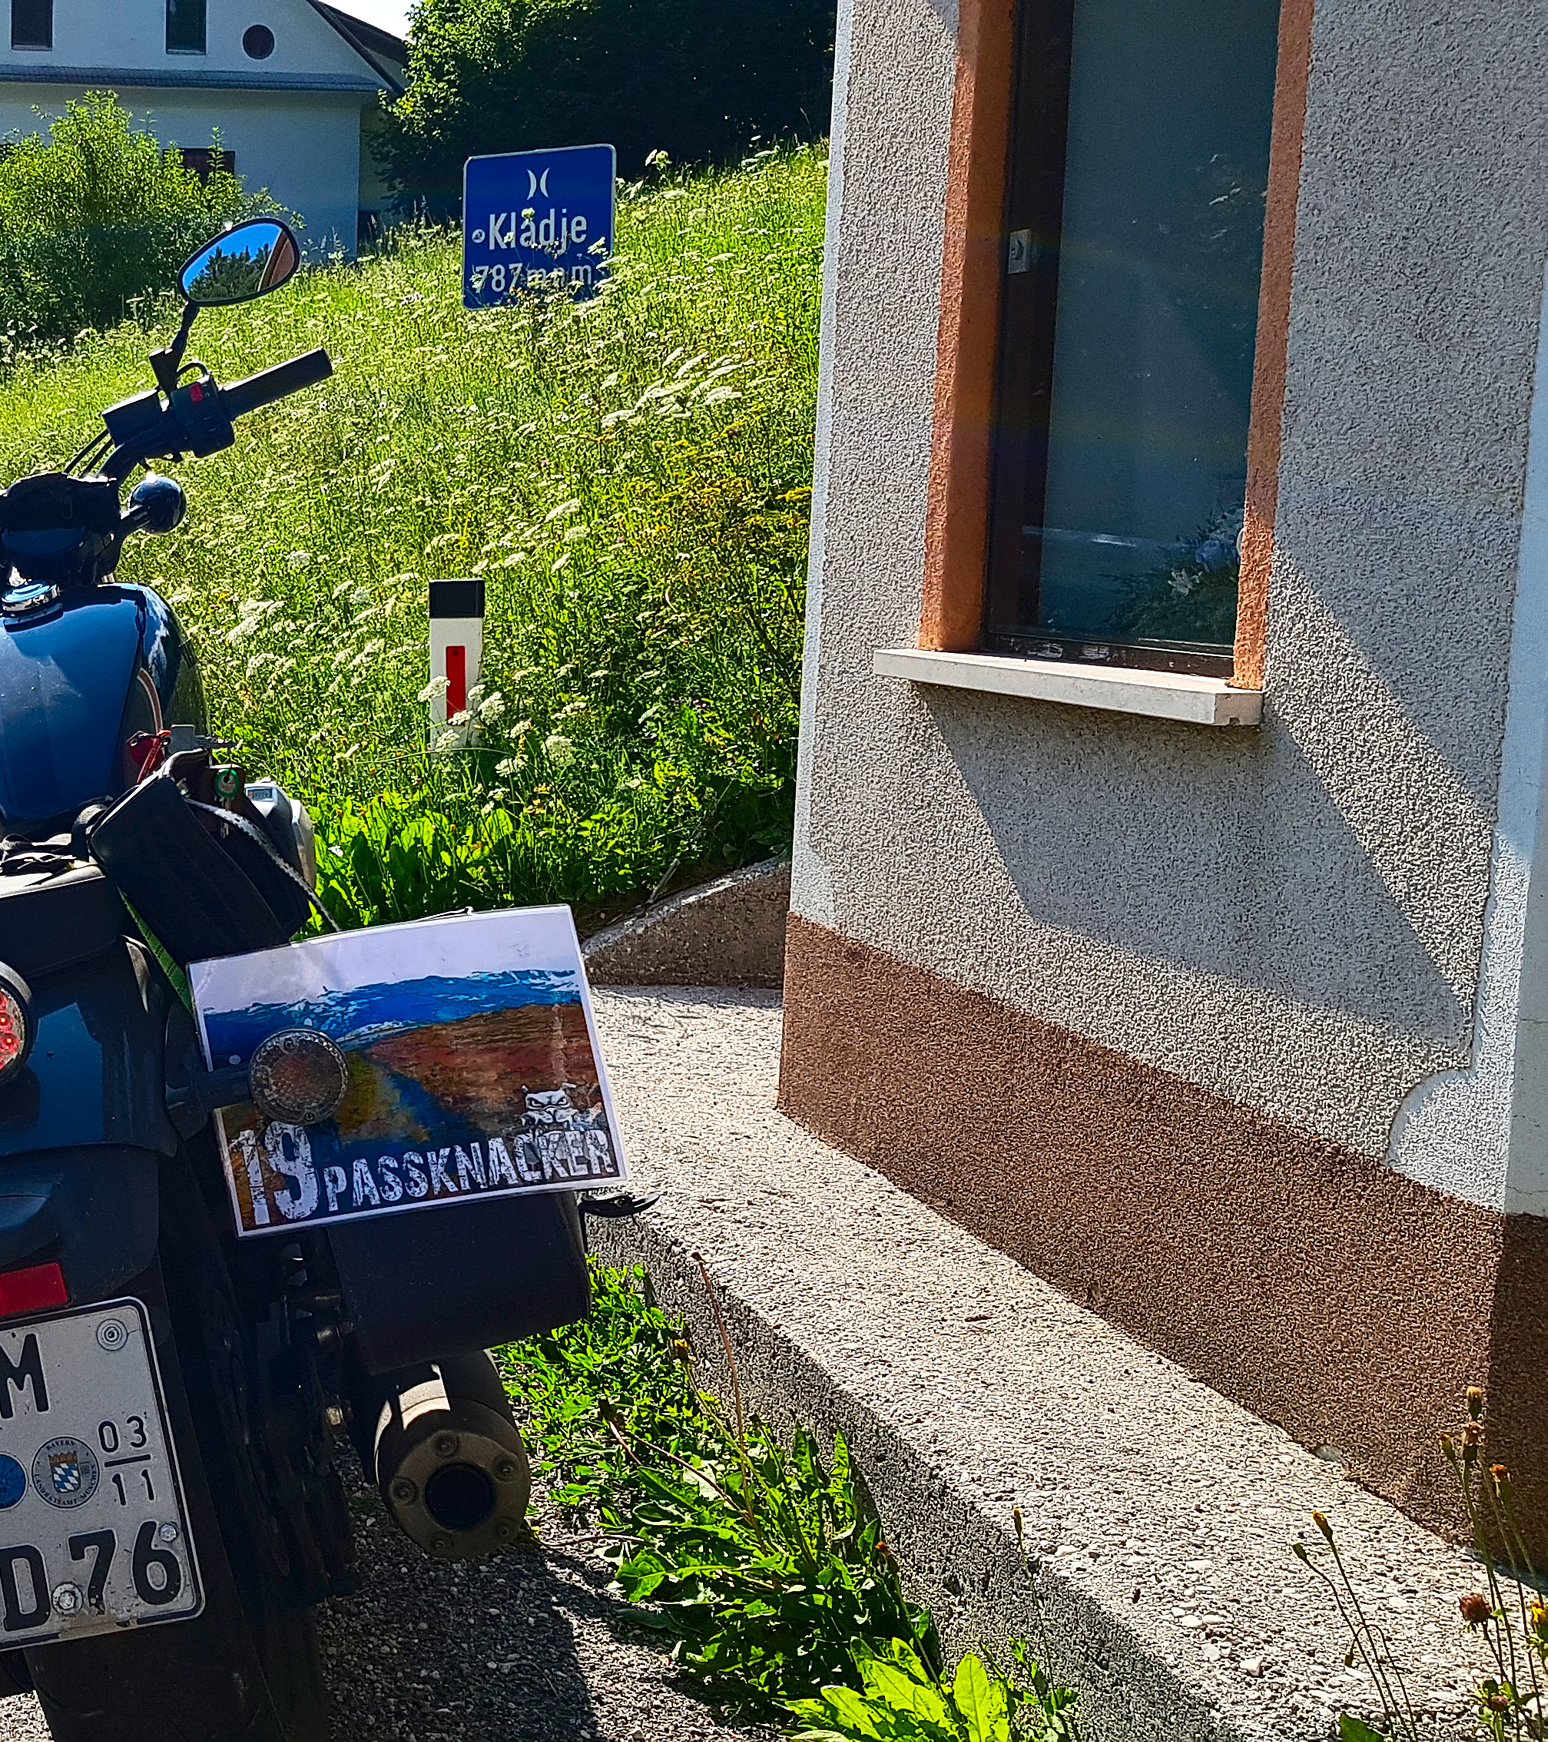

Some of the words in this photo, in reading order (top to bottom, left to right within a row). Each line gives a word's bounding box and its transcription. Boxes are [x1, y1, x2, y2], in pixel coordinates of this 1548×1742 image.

[488, 208, 588, 256] Kladje
[228, 1121, 319, 1226] 19
[324, 1129, 616, 1213] PASSKNACKER
[97, 1415, 147, 1453] 03
[111, 1468, 156, 1506] 11
